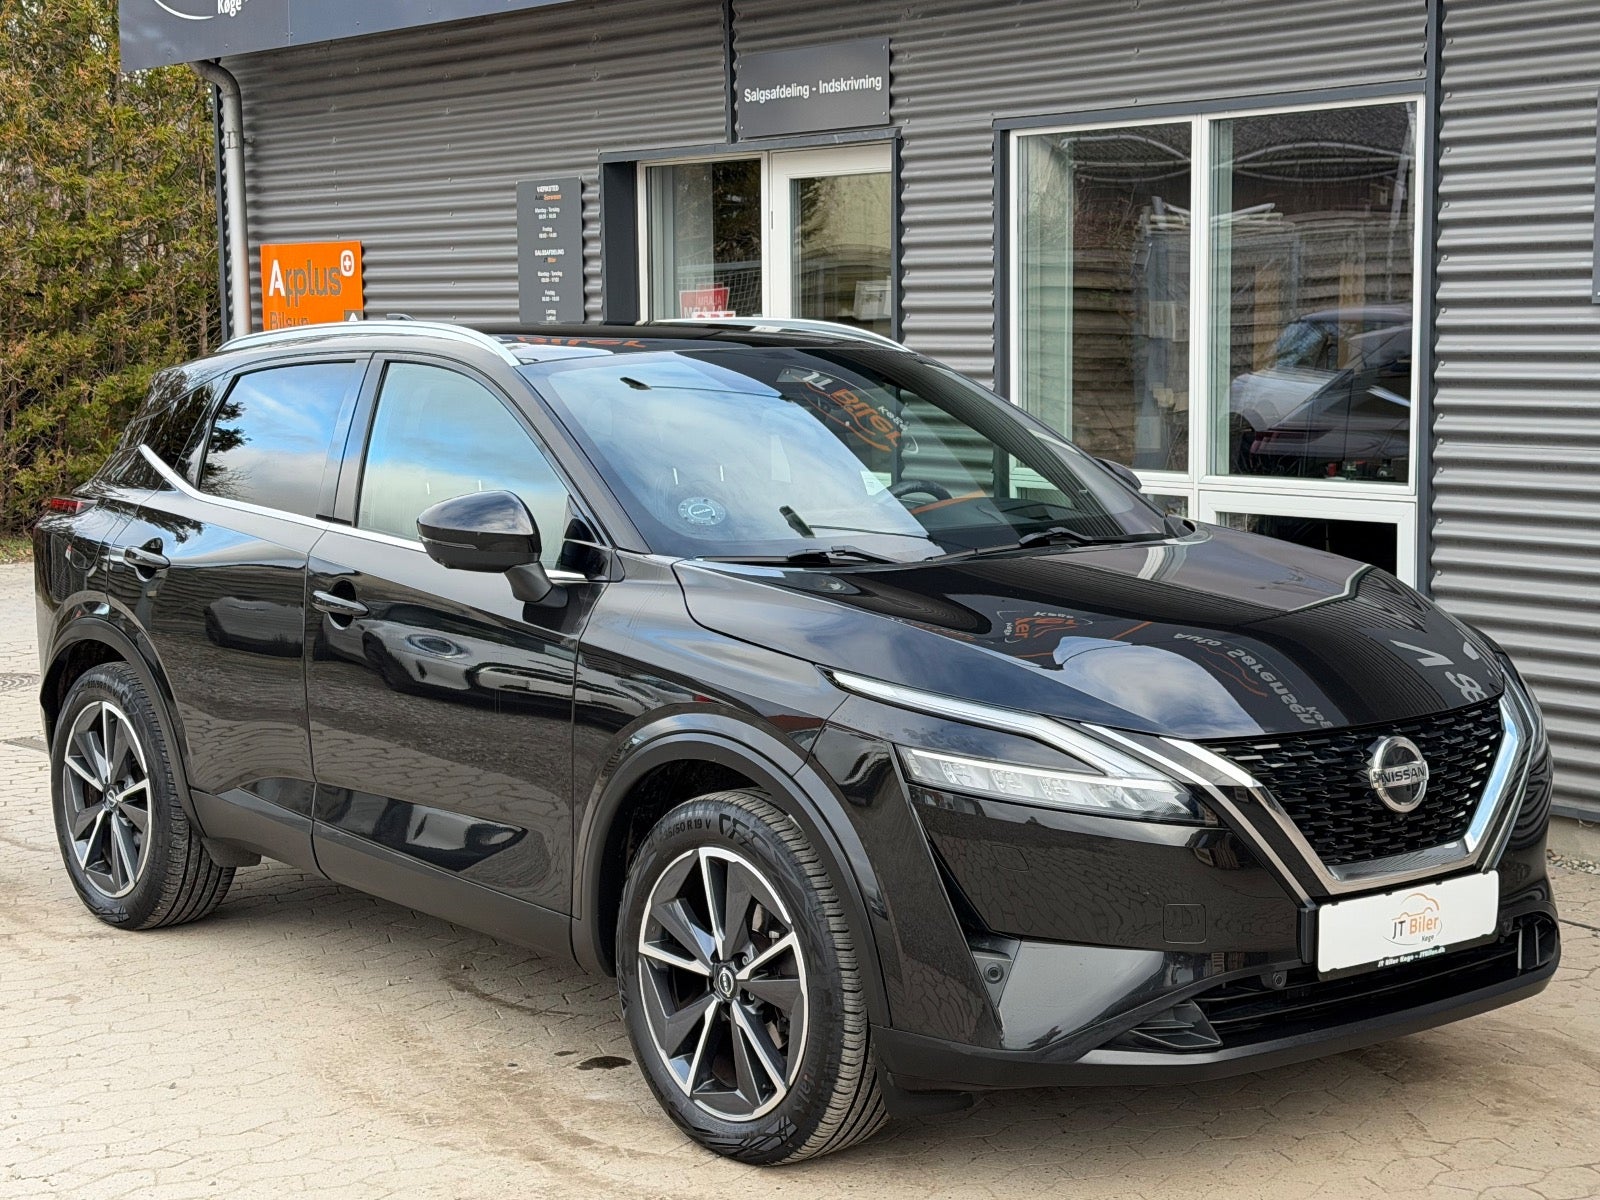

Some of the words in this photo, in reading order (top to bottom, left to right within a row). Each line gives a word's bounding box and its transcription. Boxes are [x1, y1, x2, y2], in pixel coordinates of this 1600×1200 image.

[217, 0, 242, 17] Køge
[744, 83, 810, 104] Salgsafdeling
[819, 75, 882, 94] Indskrivning
[268, 259, 342, 308] Applus
[1381, 765, 1425, 784] NISSAN
[1392, 920, 1406, 940] JT
[1409, 916, 1439, 935] Biler
